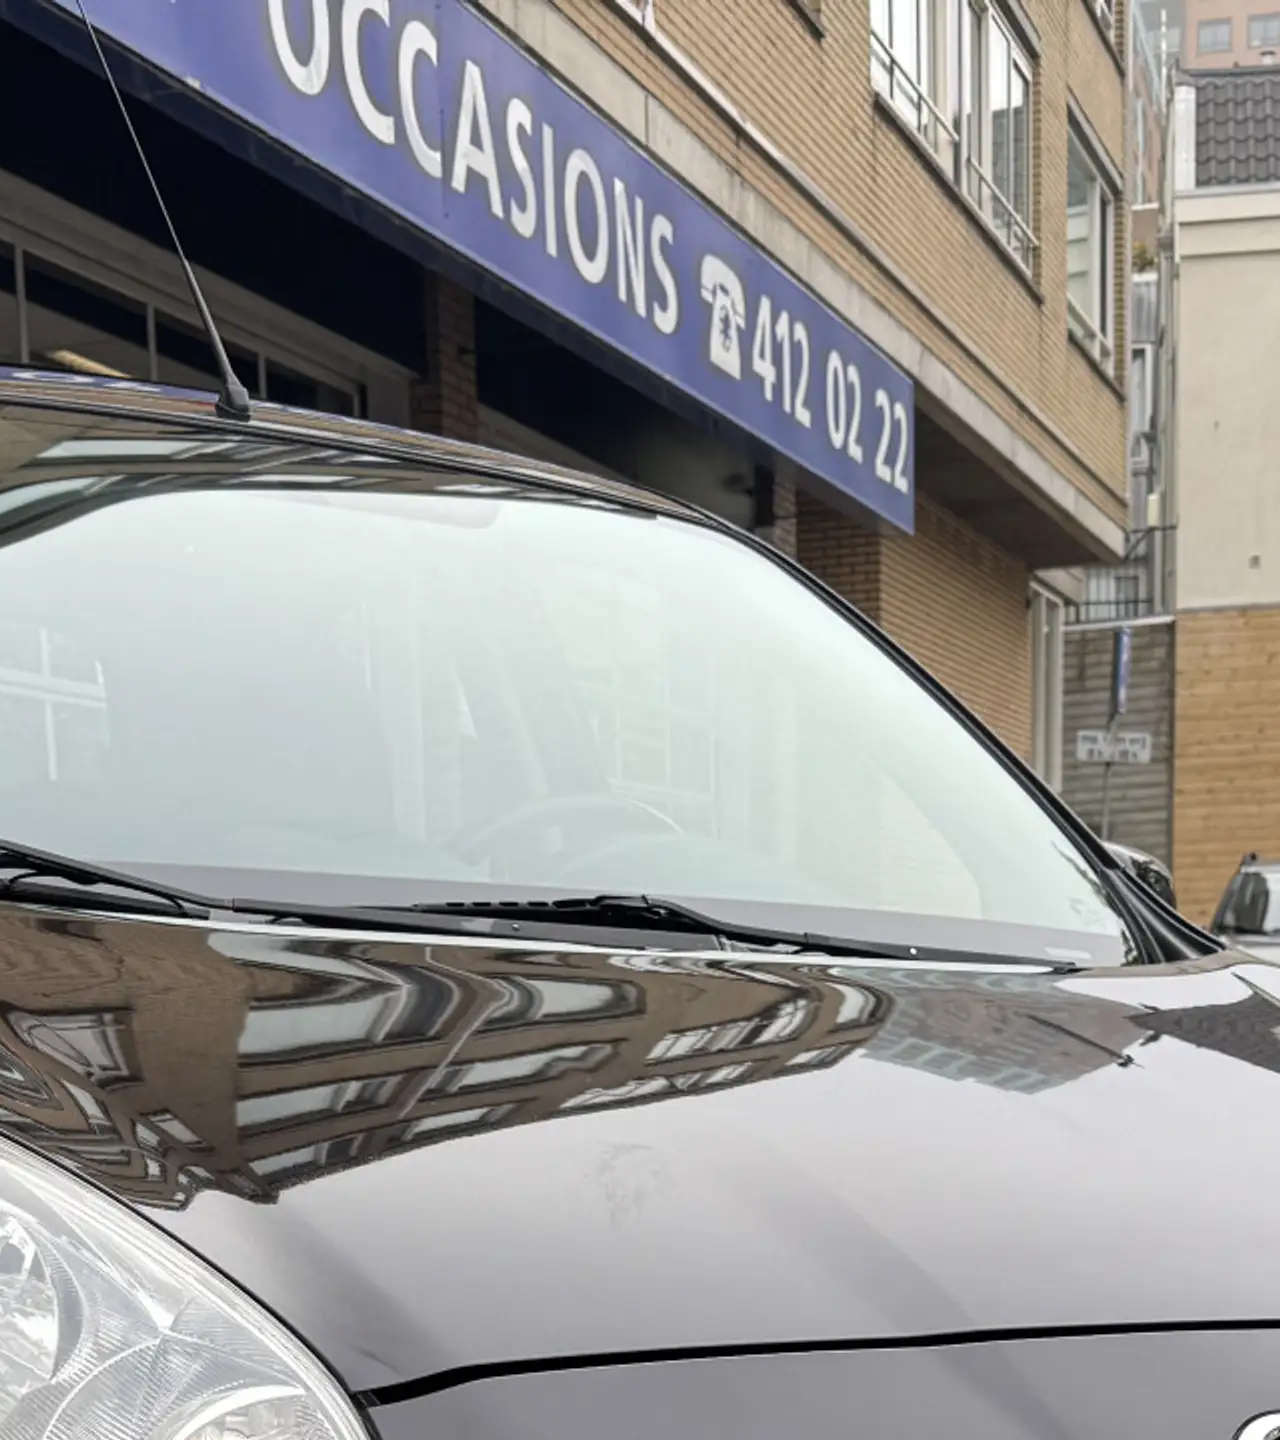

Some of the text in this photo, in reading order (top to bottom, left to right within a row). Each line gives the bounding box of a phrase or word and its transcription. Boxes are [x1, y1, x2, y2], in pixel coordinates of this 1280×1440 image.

[753, 294, 811, 429] 412
[825, 350, 864, 464] 02
[875, 389, 910, 495] 22
